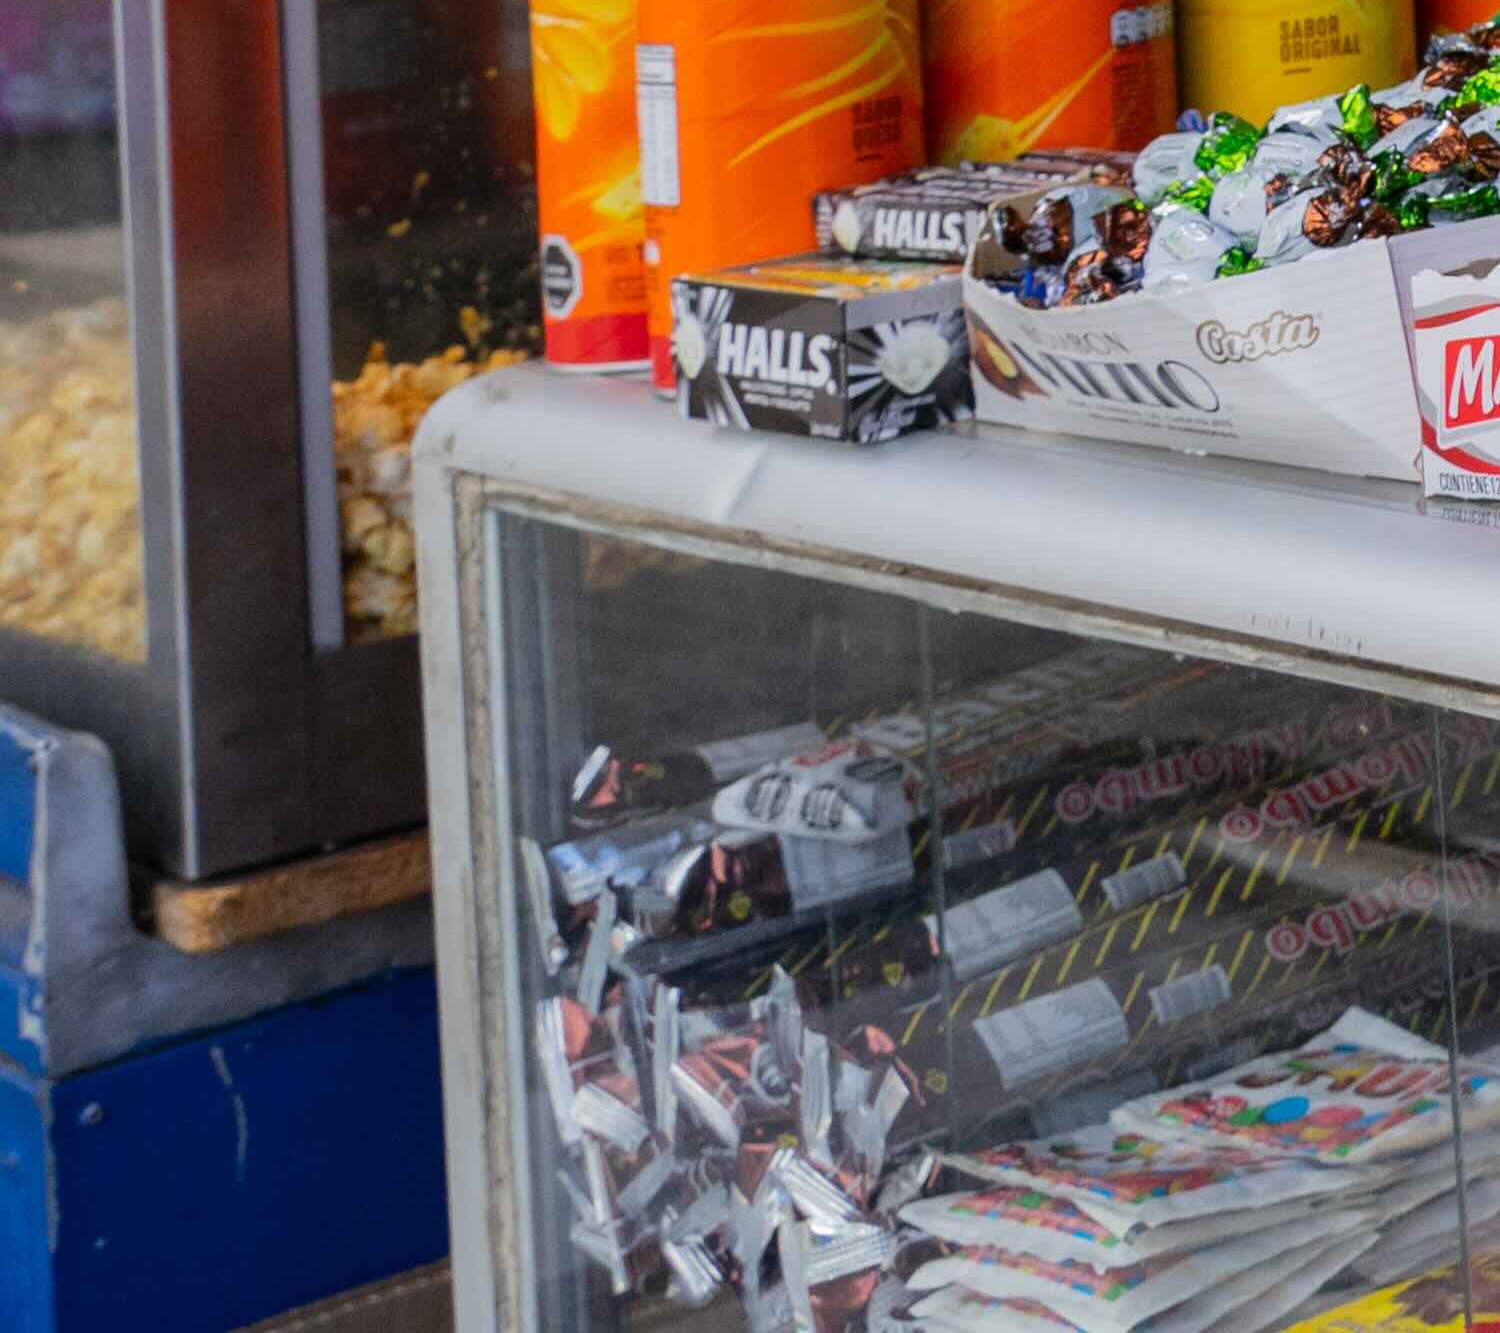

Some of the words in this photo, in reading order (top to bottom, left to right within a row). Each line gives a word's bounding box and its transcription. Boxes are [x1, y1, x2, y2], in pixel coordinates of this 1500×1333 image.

[1279, 16, 1340, 38] SABOR
[1279, 35, 1361, 63] ORIGINAL
[874, 208, 964, 251] HALLS
[719, 324, 832, 383] HALLS
[1196, 311, 1320, 364] Costa
[1439, 472, 1489, 496] CONTIENE
